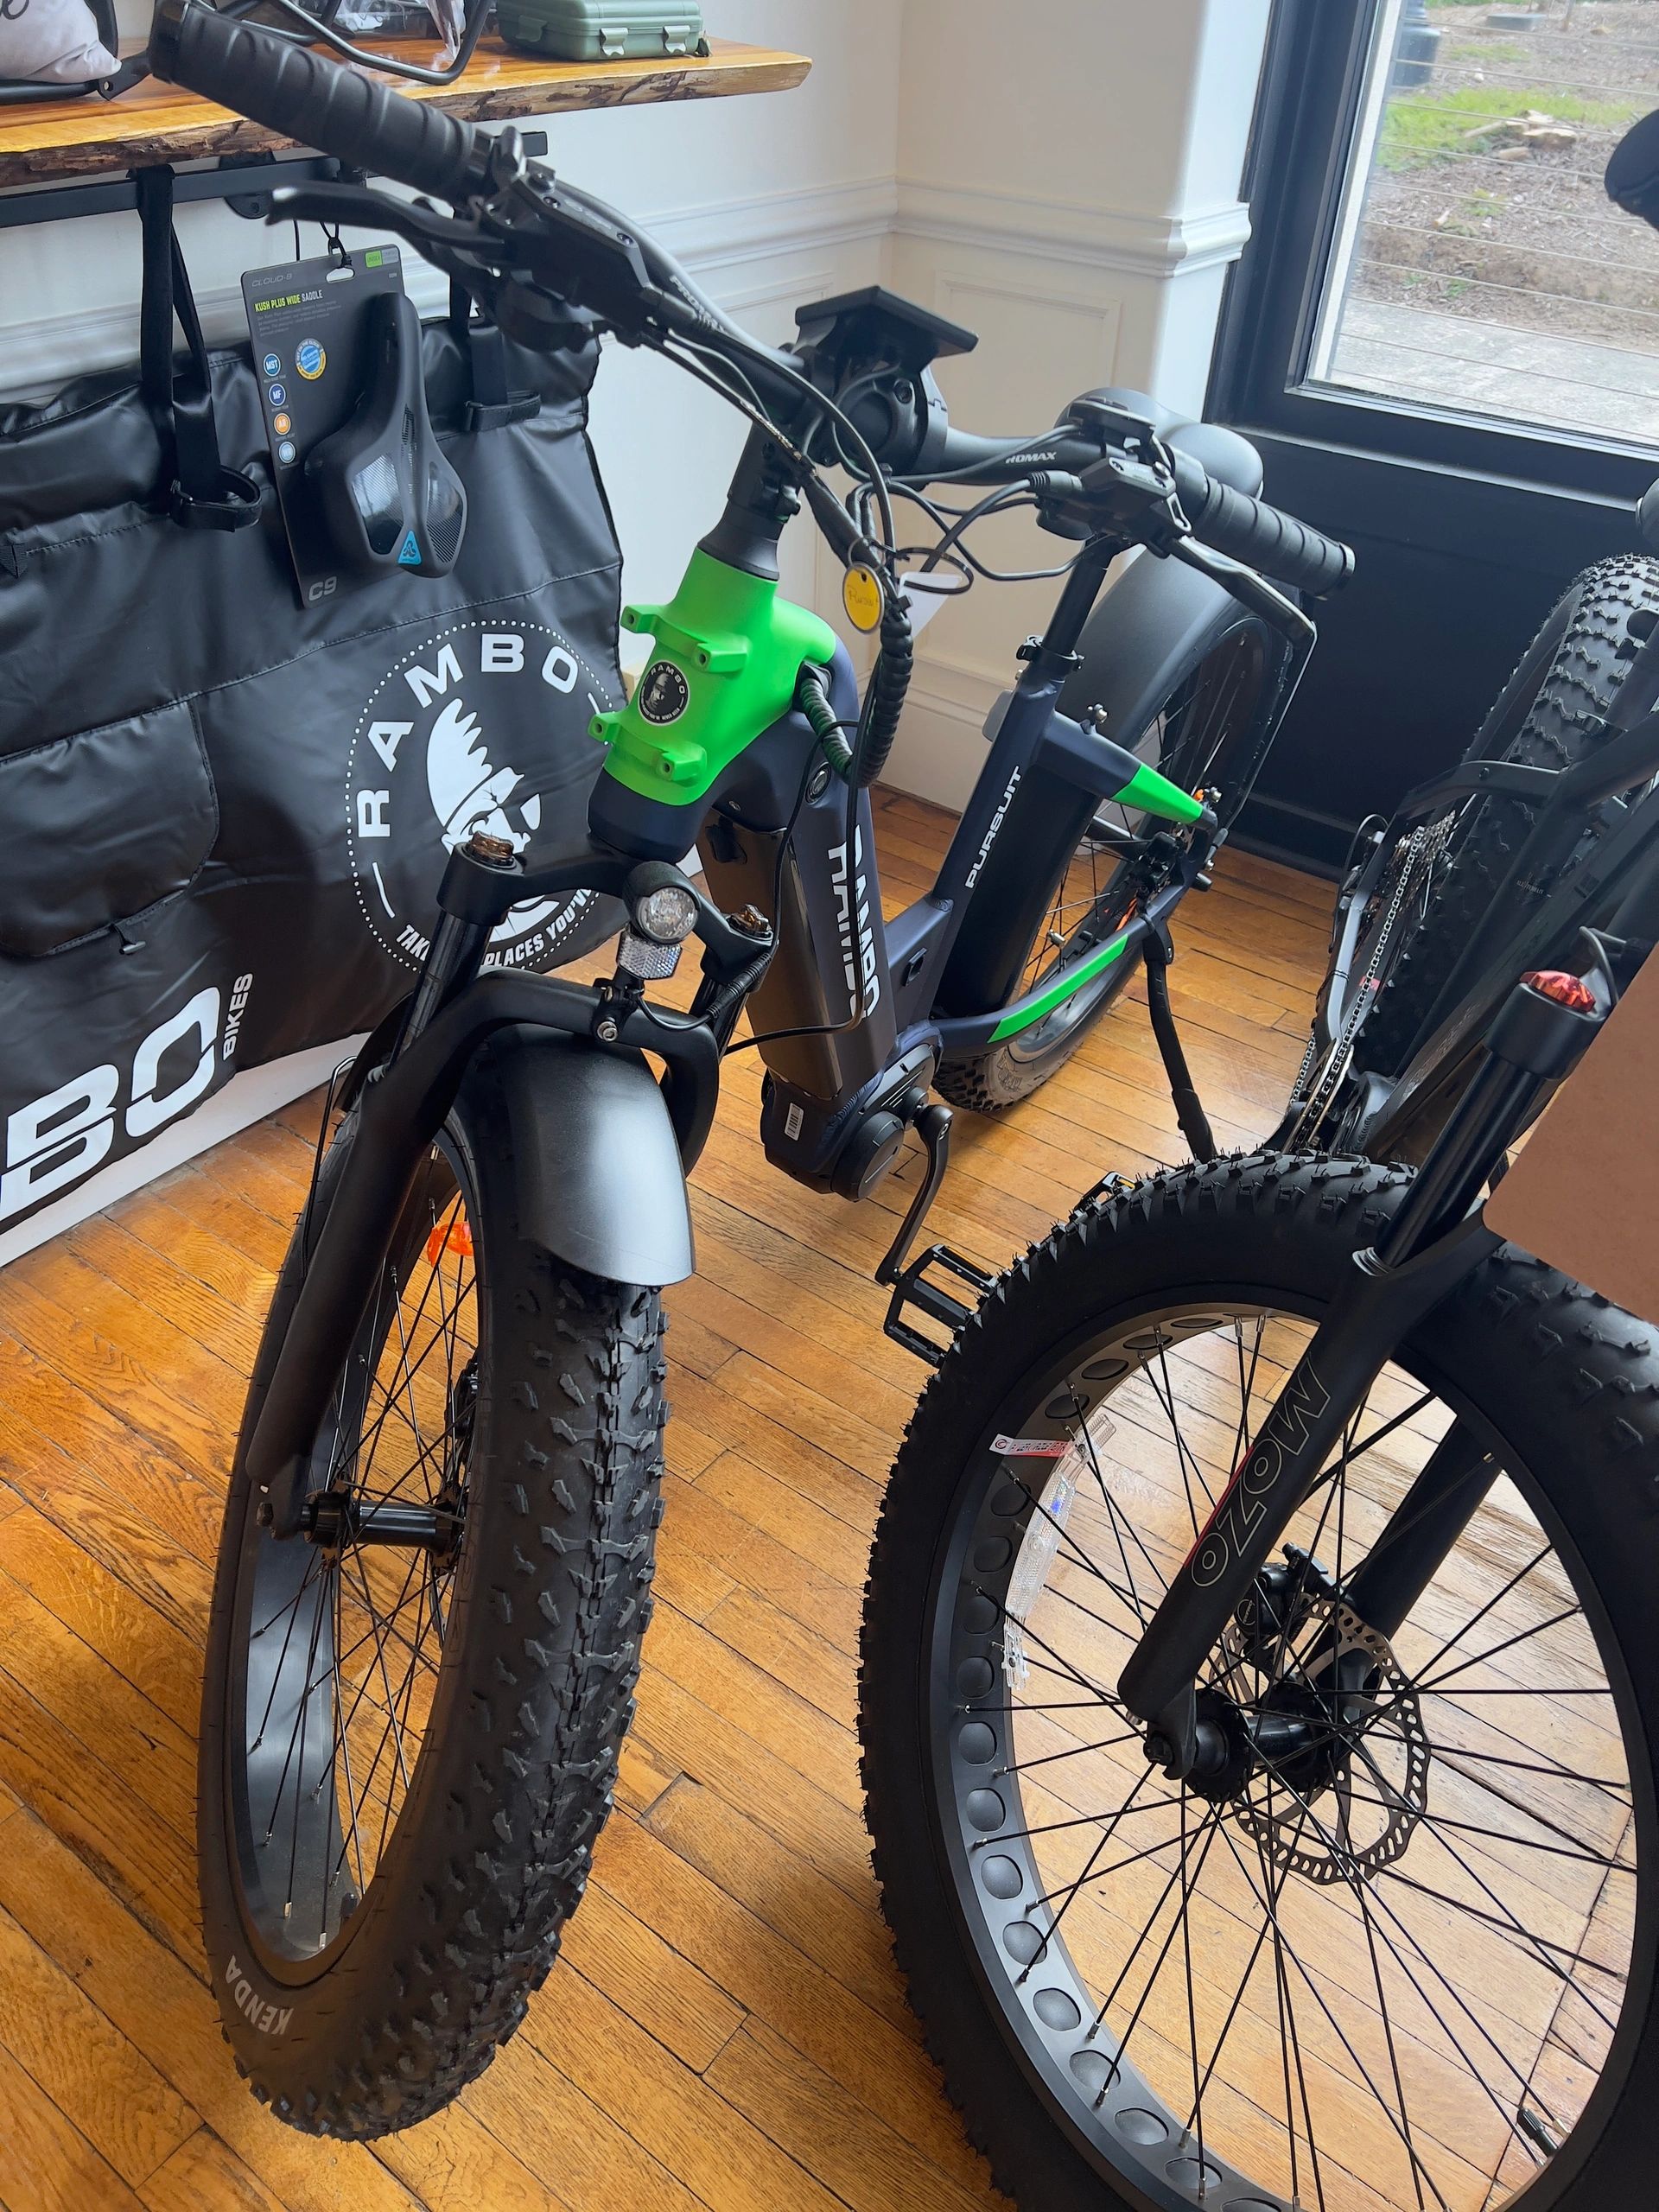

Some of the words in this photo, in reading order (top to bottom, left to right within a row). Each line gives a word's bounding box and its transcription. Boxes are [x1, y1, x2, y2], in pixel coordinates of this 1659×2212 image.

[255, 301, 270, 313] KUSH
[271, 297, 286, 309] PLUS
[286, 294, 301, 306] WIDE
[302, 289, 323, 302] SADDLE
[265, 359, 278, 372] MST
[1006, 452, 1057, 465] ROMAX
[308, 576, 338, 601] C9
[651, 664, 686, 695] RAMBO
[356, 633, 579, 838] RAMBO
[964, 766, 1021, 888] PURSUIT
[483, 934, 545, 967] PLACES
[223, 973, 254, 1061] BIKES
[1191, 1357, 1332, 1587] MOZO
[225, 1954, 295, 2036] KENDA
